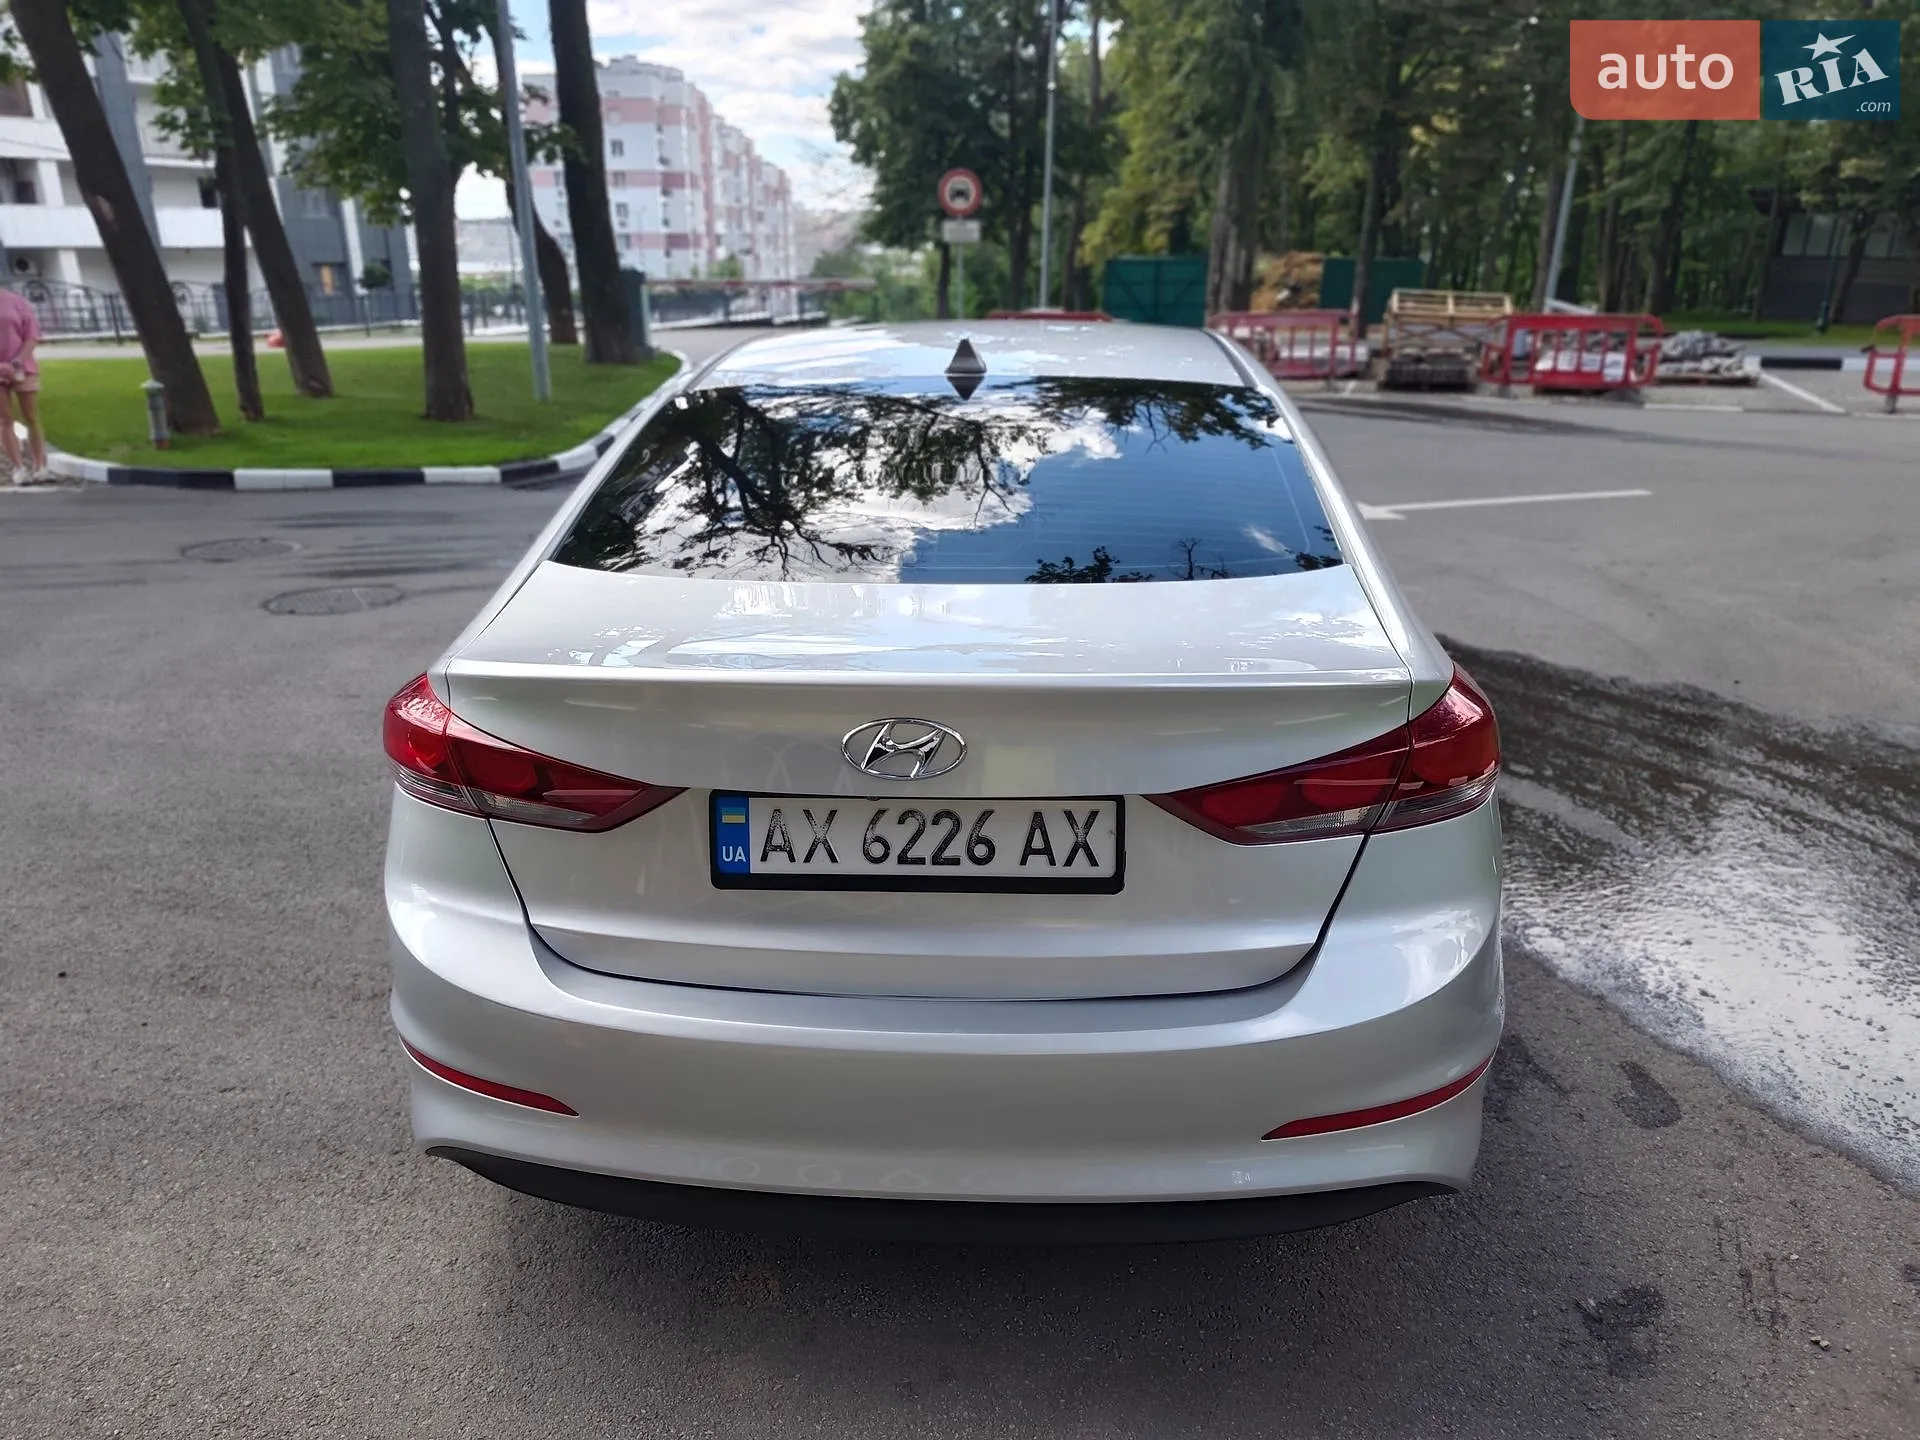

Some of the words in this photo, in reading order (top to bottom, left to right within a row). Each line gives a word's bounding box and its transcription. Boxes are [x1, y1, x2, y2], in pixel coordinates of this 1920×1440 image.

[722, 846, 747, 862] UA
[760, 809, 839, 864] AX
[862, 809, 997, 866] 6226
[1019, 810, 1101, 867] AX
